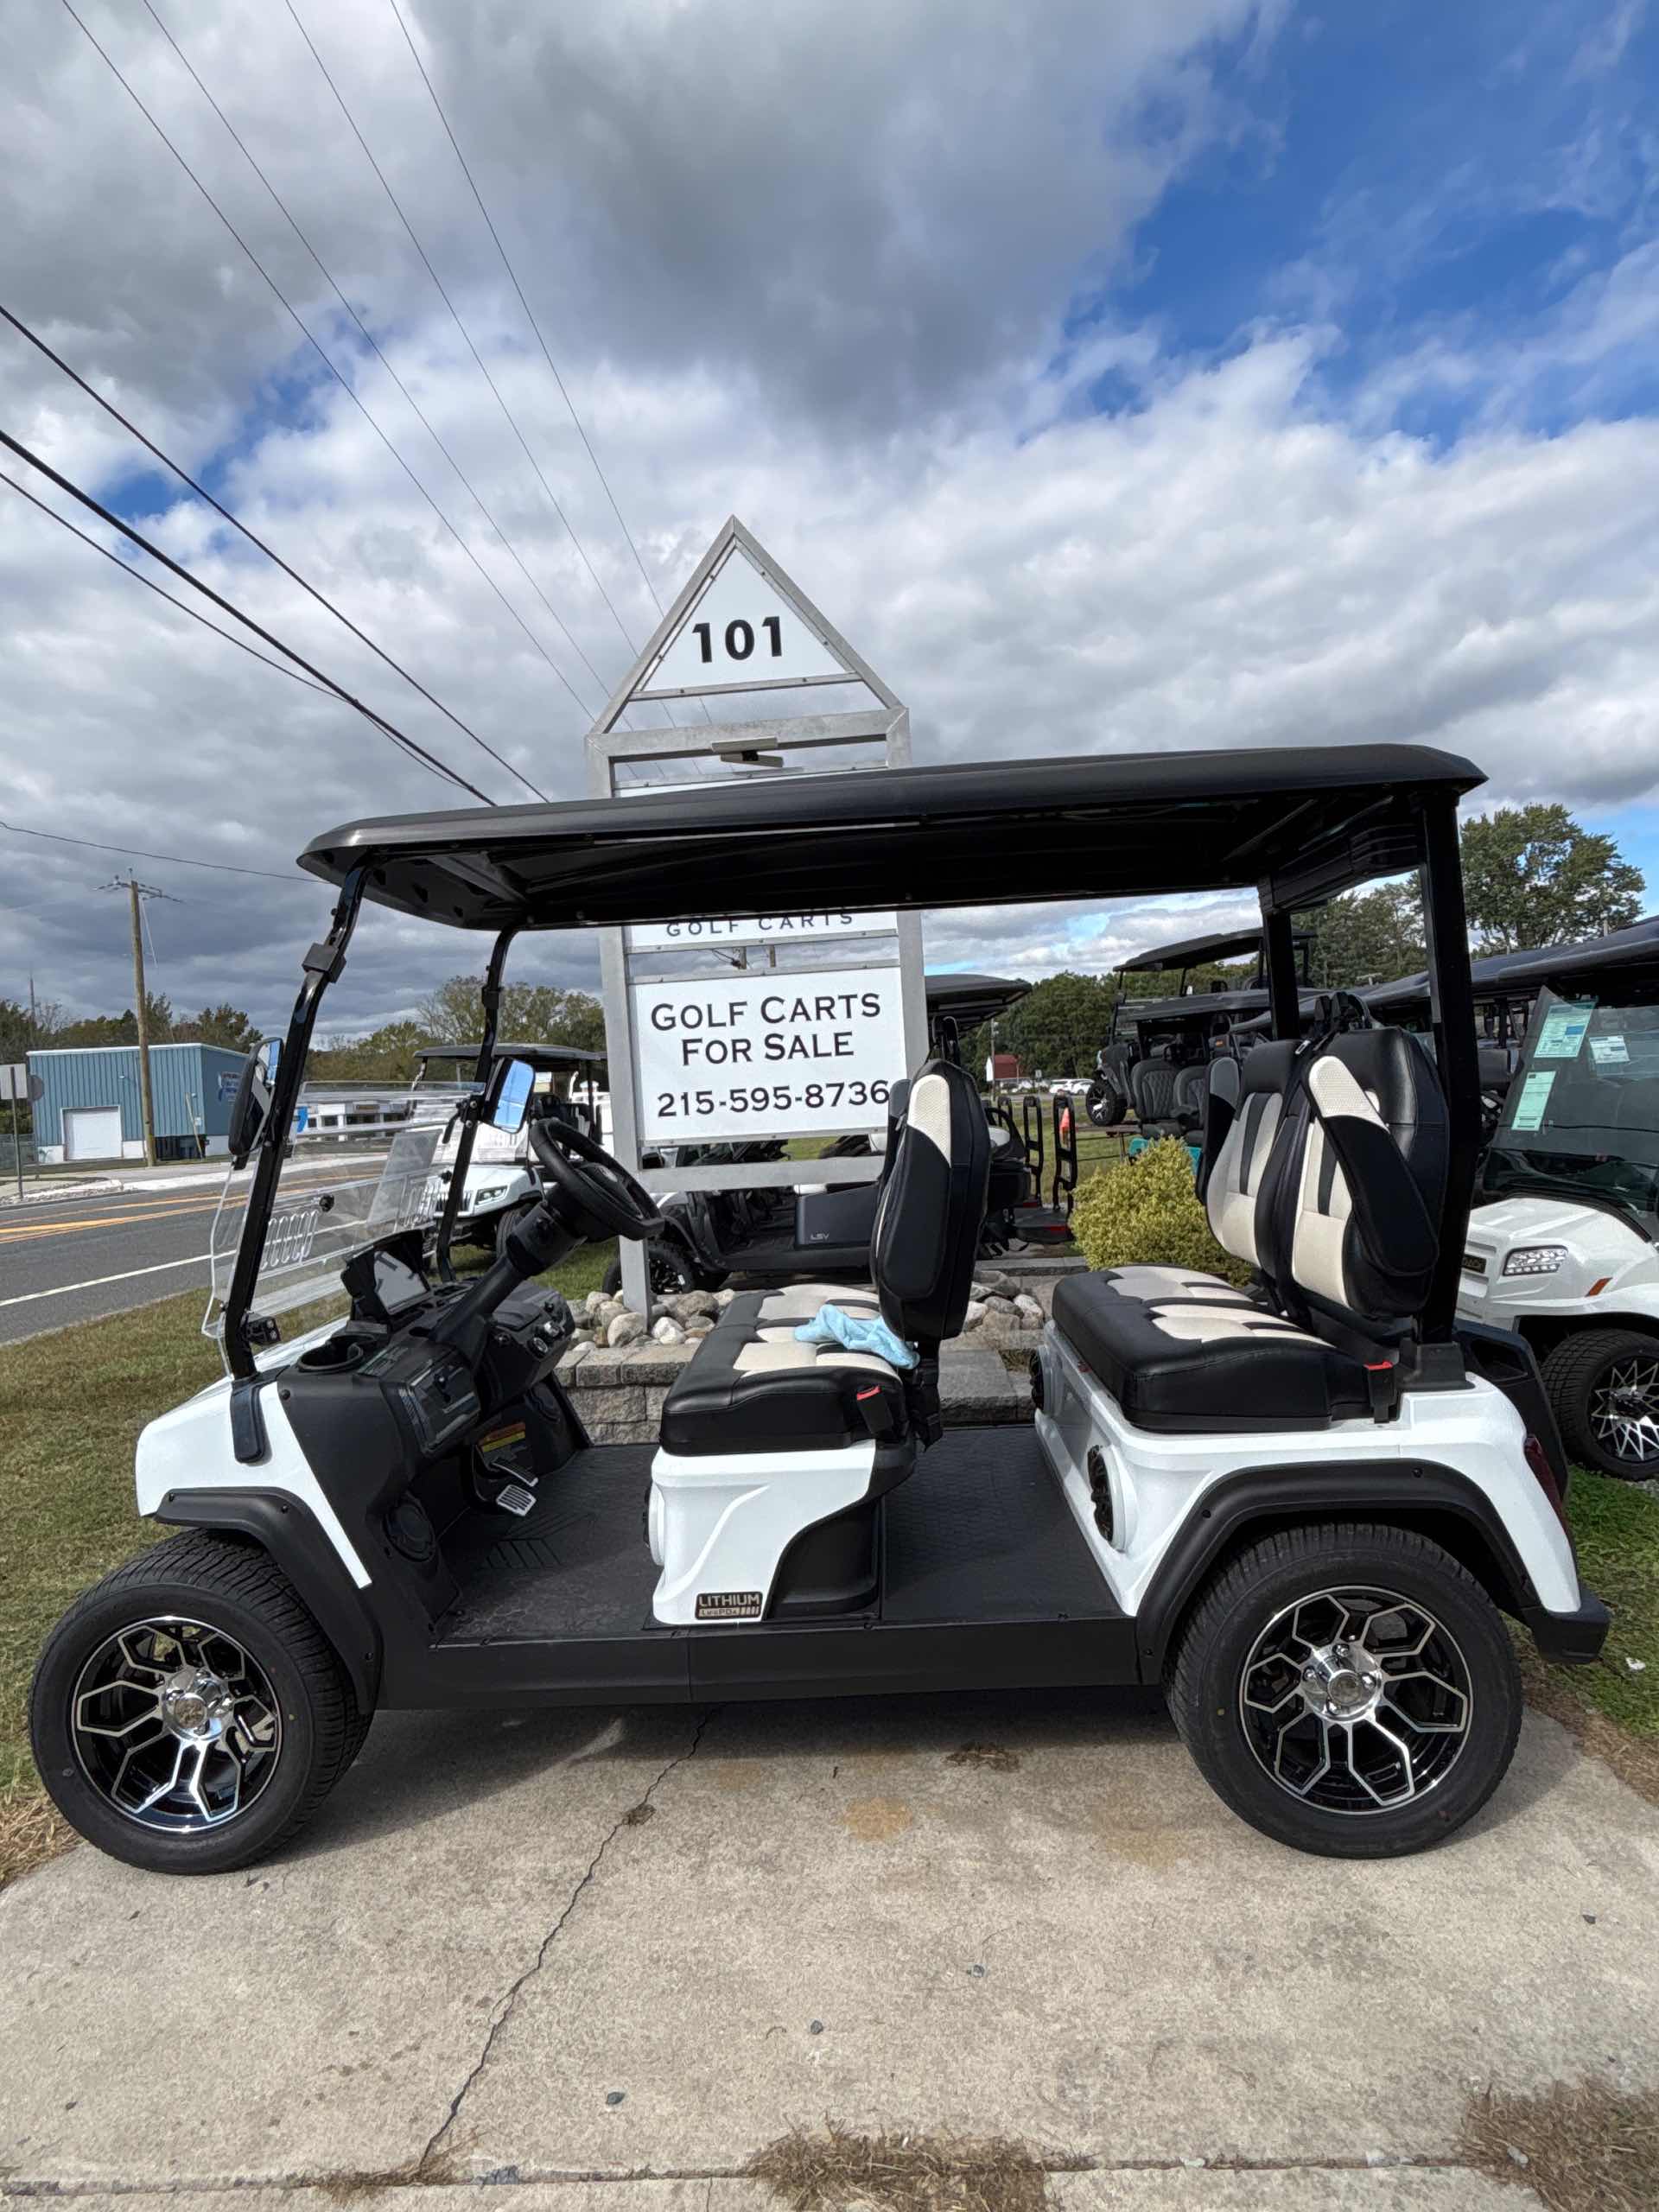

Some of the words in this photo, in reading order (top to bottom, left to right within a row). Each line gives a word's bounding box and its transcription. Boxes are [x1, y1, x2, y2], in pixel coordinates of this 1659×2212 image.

[692, 616, 782, 663] 101
[666, 919, 739, 937] GOLF
[651, 1001, 748, 1031] GOLF
[760, 993, 881, 1025] CARTS
[682, 1038, 752, 1066] FOR
[764, 1032, 854, 1060] SALE
[658, 1079, 890, 1117] 215-595-8736
[698, 1593, 760, 1607] LITHIUM
